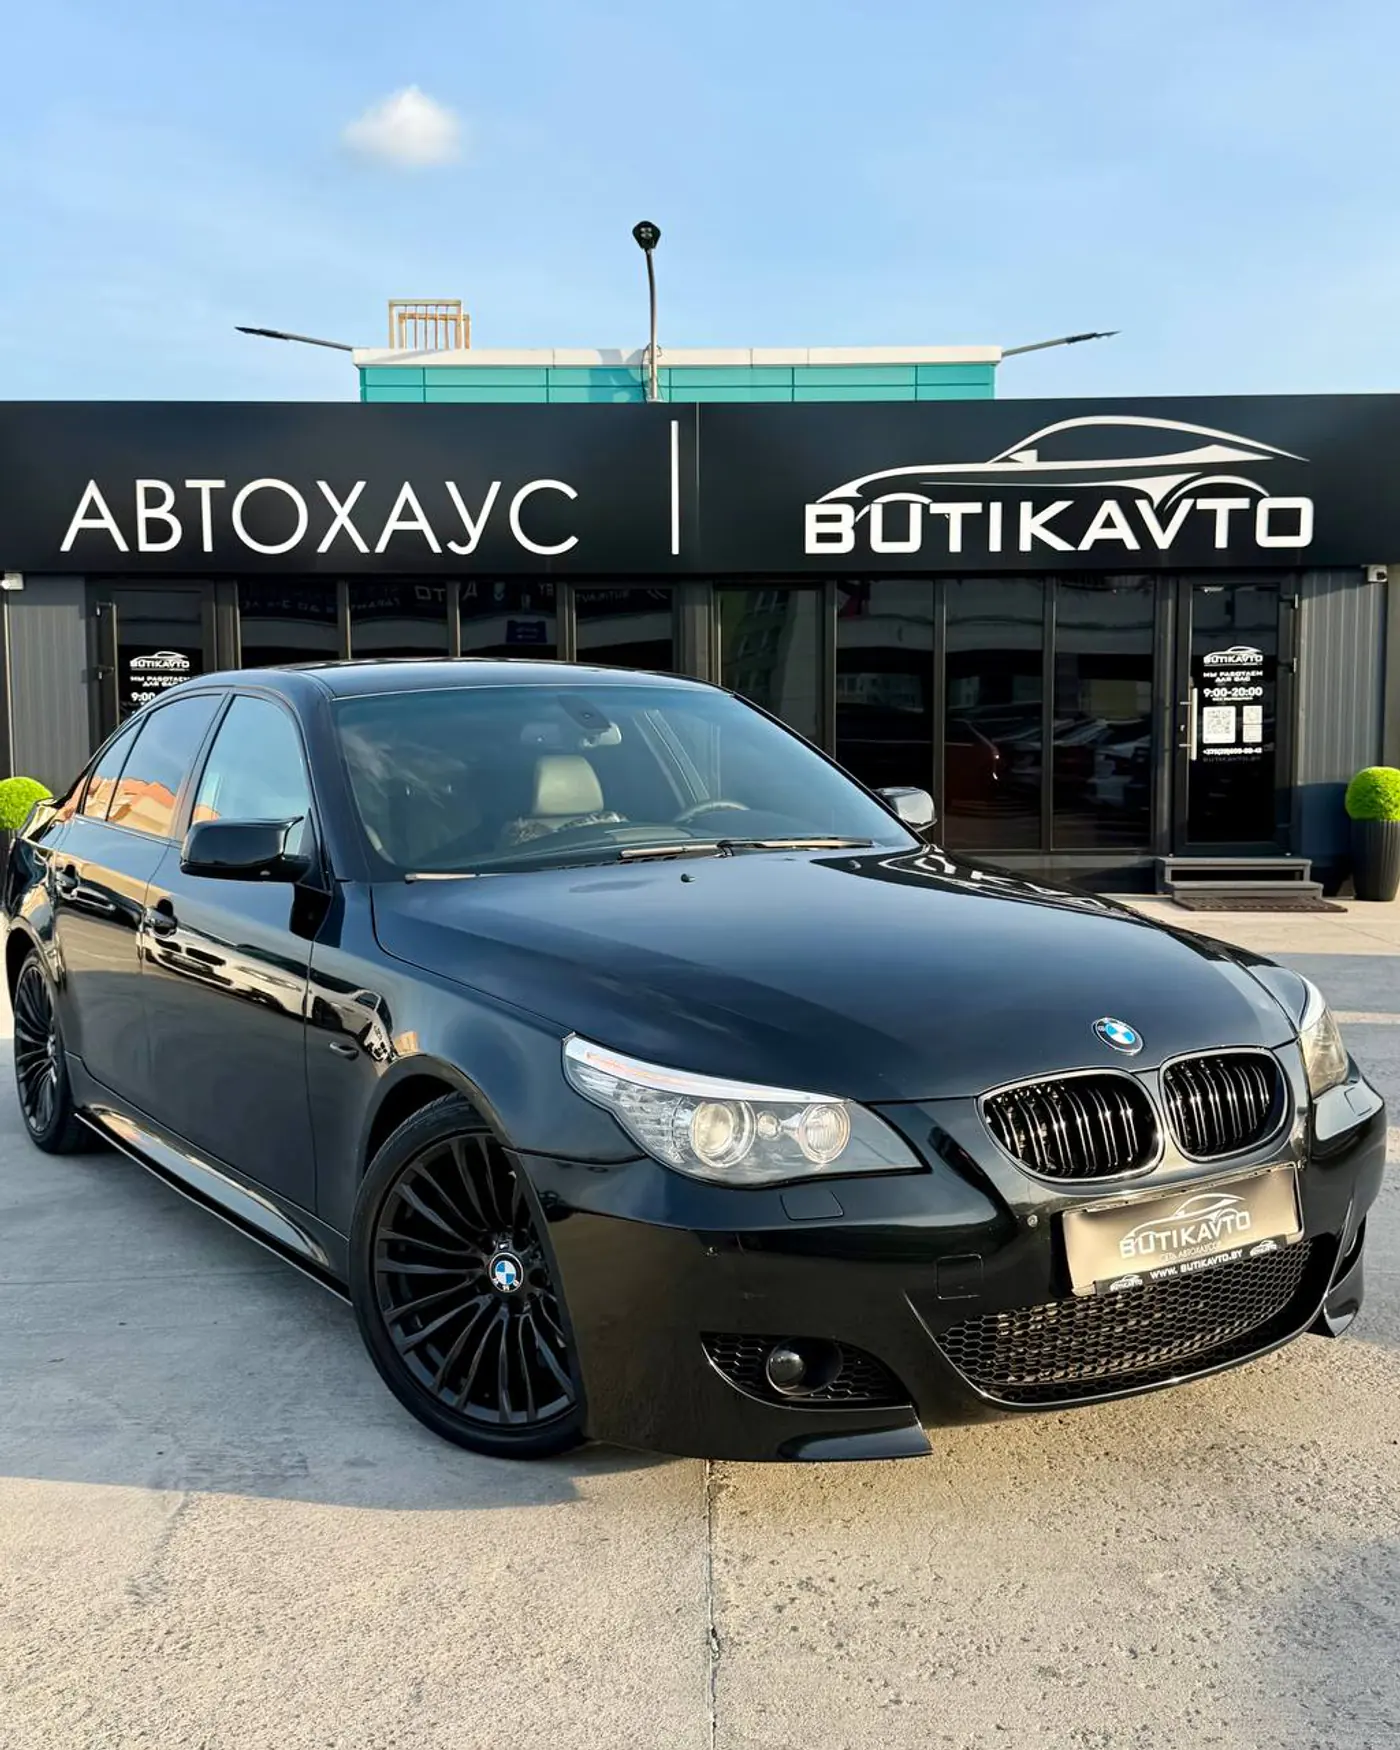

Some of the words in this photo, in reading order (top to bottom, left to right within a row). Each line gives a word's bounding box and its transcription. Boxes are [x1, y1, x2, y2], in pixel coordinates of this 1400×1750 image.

[60, 479, 579, 555] АВТОХАУС
[805, 496, 1314, 554] BUTIKAVTO
[1203, 655, 1263, 664] BUTIKAVTO
[1203, 686, 1263, 698] 9:00-20:00
[1120, 1211, 1250, 1258] BUTIKAVTO
[1180, 1249, 1242, 1272] BUTIKAVTO.BY
